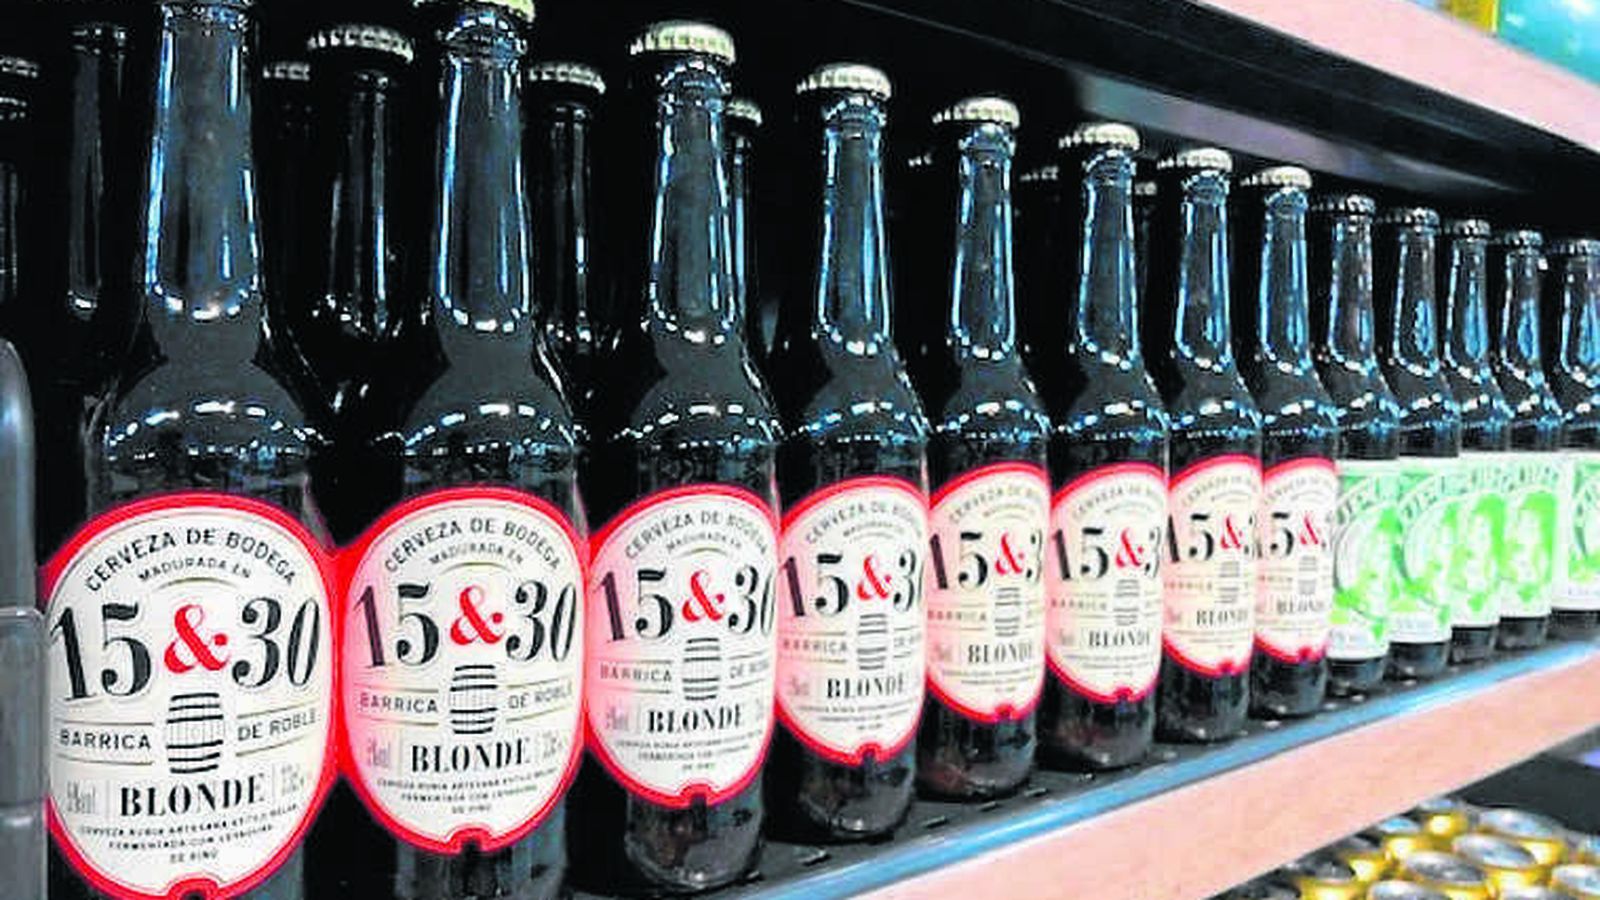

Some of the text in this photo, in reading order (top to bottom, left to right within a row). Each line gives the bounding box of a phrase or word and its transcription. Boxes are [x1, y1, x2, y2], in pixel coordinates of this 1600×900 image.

[384, 517, 561, 573] CERVEZA DE BODEGA
[624, 513, 695, 559] CERVEZA
[85, 529, 297, 592] CERVEZA DE BODEGA
[359, 691, 438, 713] BARRICA
[508, 693, 530, 709] DE
[648, 703, 742, 733] BLONDE
[59, 708, 318, 750] BARRICA DE ROBLE
[411, 737, 531, 773] BLONDE
[120, 773, 265, 816] BLONDE
